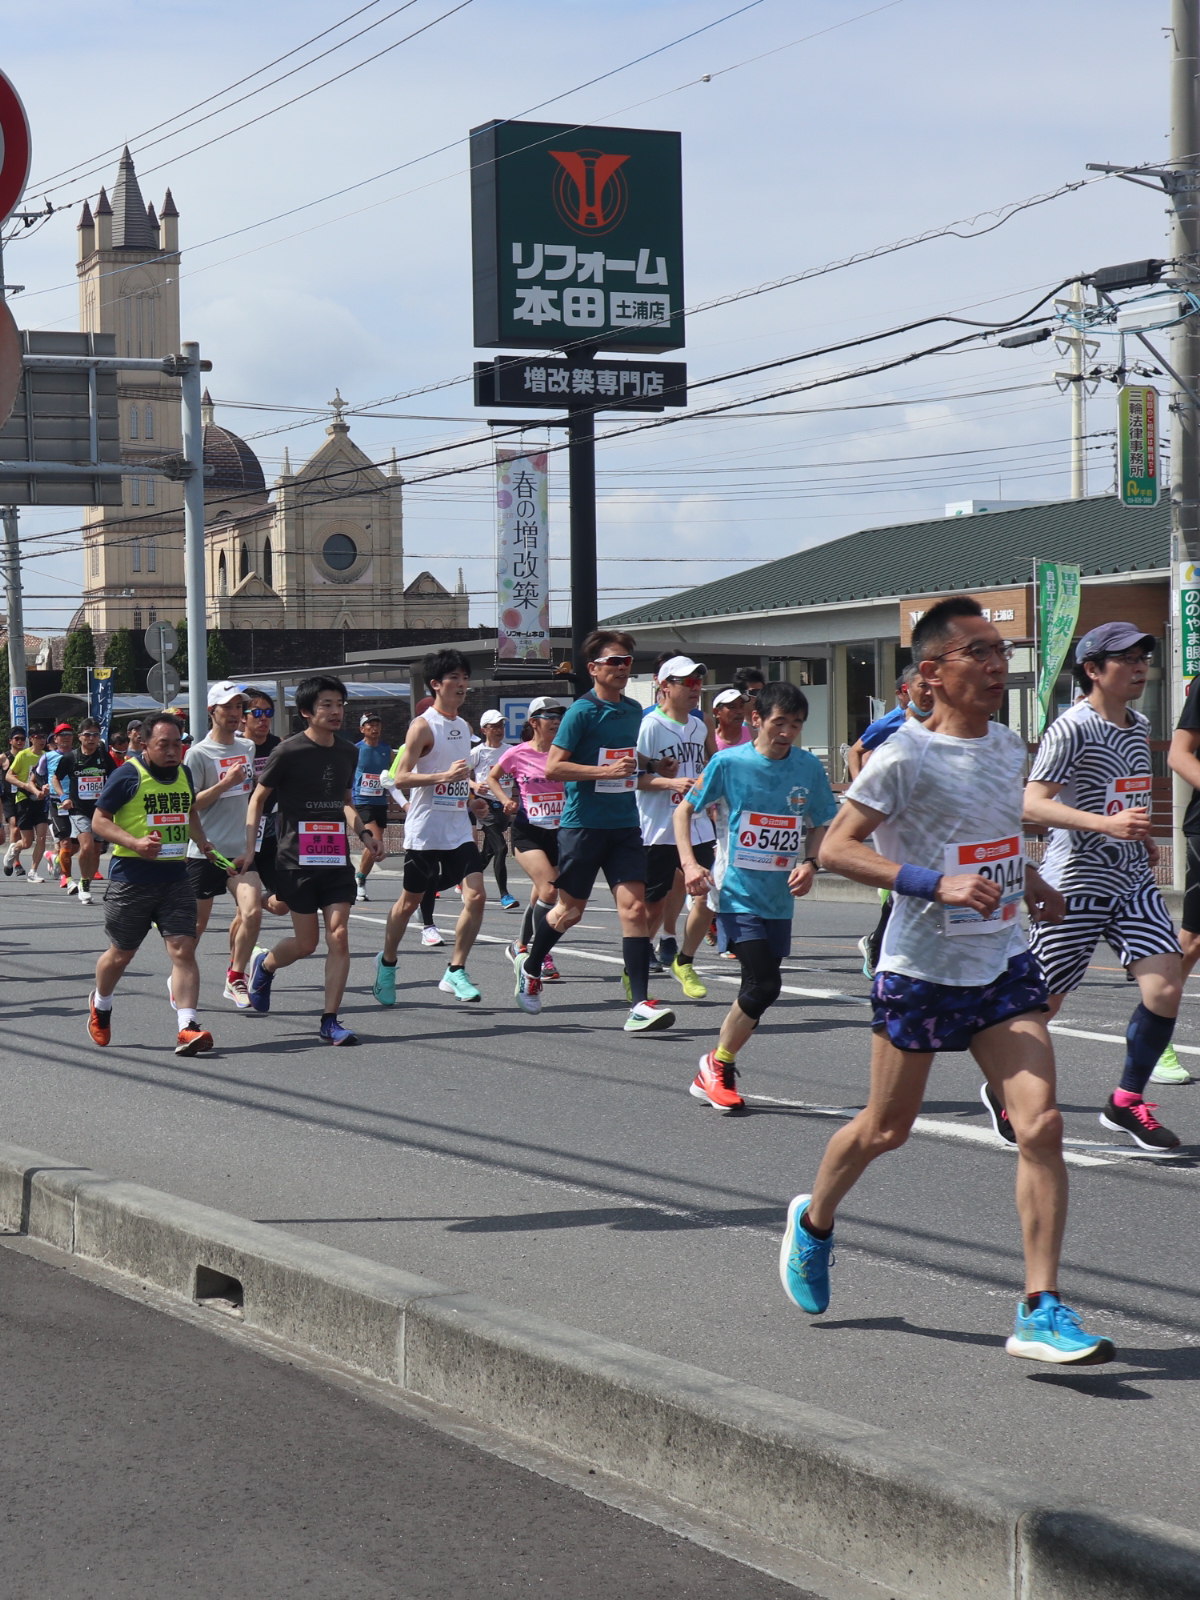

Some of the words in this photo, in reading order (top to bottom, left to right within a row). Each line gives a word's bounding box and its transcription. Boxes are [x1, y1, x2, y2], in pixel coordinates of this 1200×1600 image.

[512, 242, 668, 285] リフォーム
[513, 286, 605, 328] 本田
[615, 300, 665, 320] 土浦店
[524, 366, 664, 396] 増改築専門店
[1129, 390, 1143, 477] 三輪法律事務所
[513, 470, 539, 609] 春の増改築
[1061, 572, 1079, 598] 畳
[993, 609, 1014, 621] 土浦店
[506, 630, 545, 638] リフォーム本田
[1185, 590, 1200, 674] ののやま眼科
[86, 782, 103, 791] 1864
[447, 783, 468, 796] 6863
[143, 792, 191, 814] 視覚障害
[165, 825, 186, 842] 131
[758, 829, 799, 851] 5423
[306, 845, 340, 854] GUIDE
